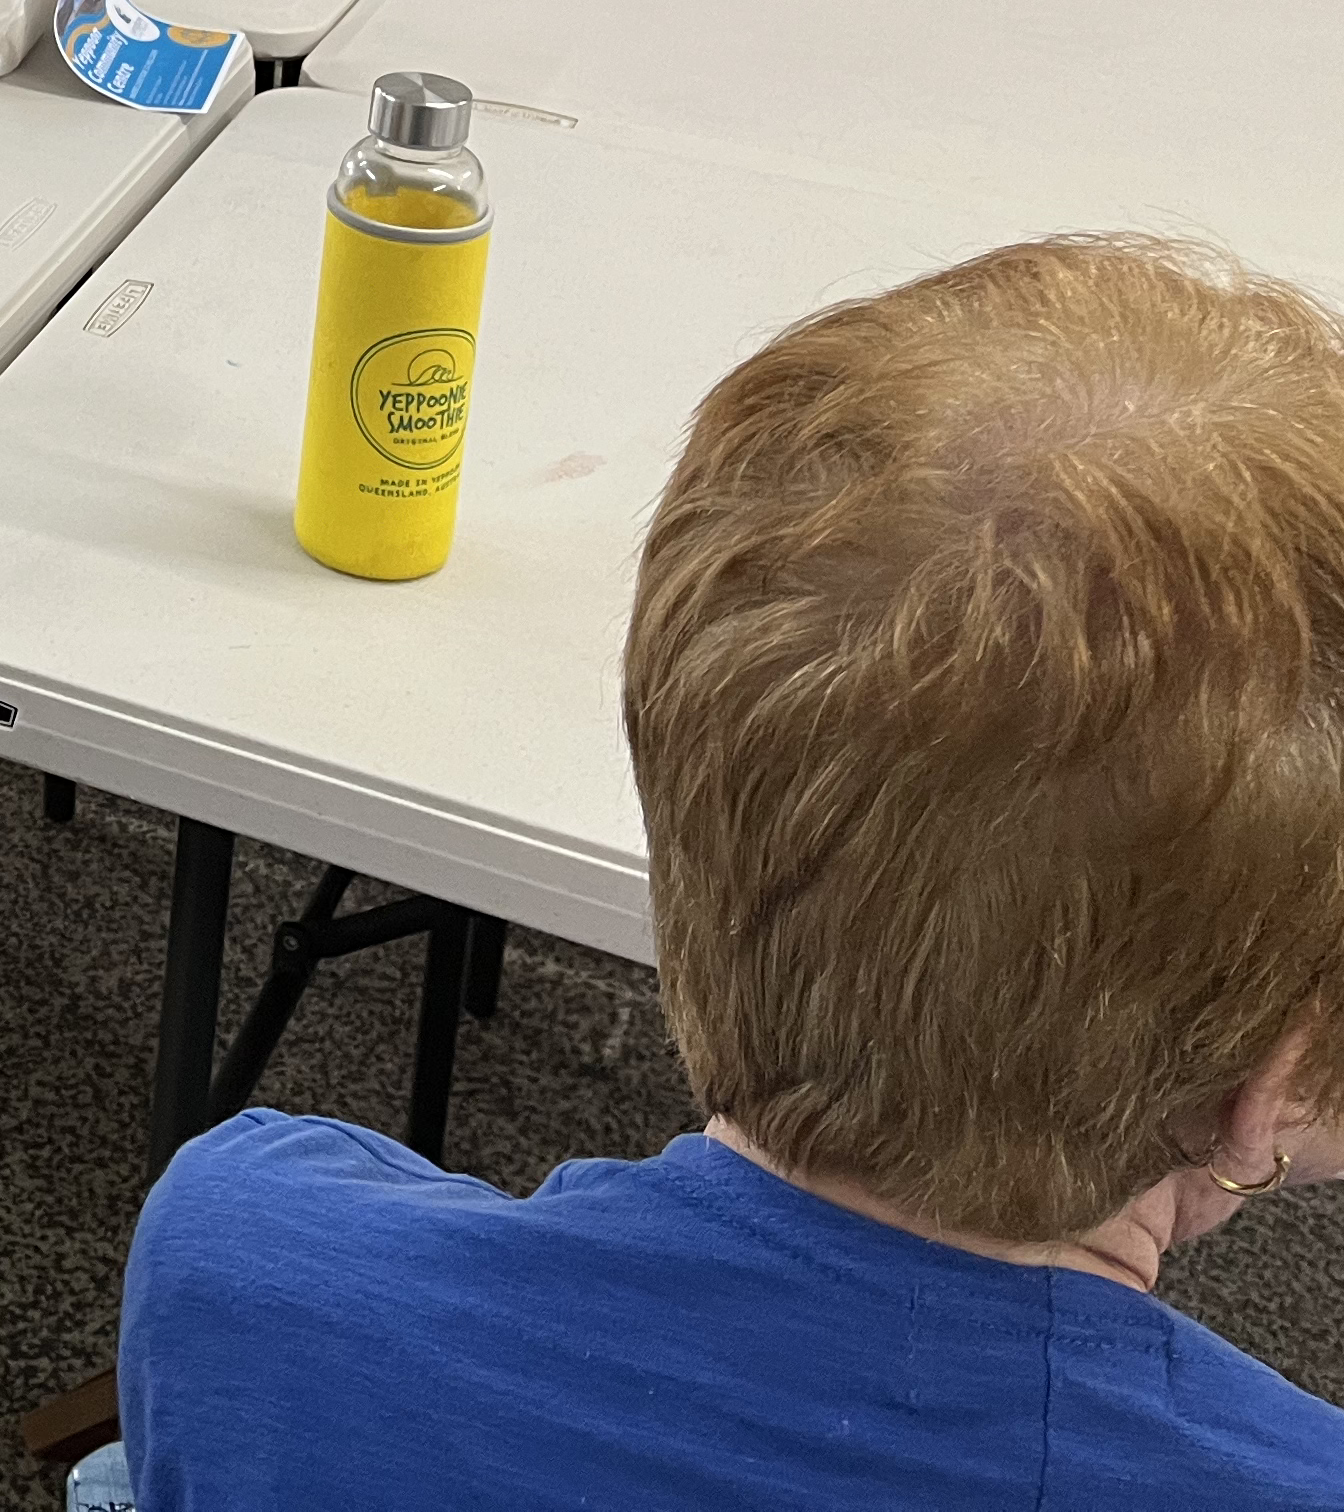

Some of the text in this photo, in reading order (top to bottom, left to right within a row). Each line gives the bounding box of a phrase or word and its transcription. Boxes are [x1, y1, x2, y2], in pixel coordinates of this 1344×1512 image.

[73, 27, 103, 69] Yeppoon
[88, 30, 129, 84] Community
[107, 62, 135, 94] Centre
[387, 402, 466, 434] SMOOTHIE
[380, 478, 410, 488] MADE
[416, 478, 428, 487] IN
